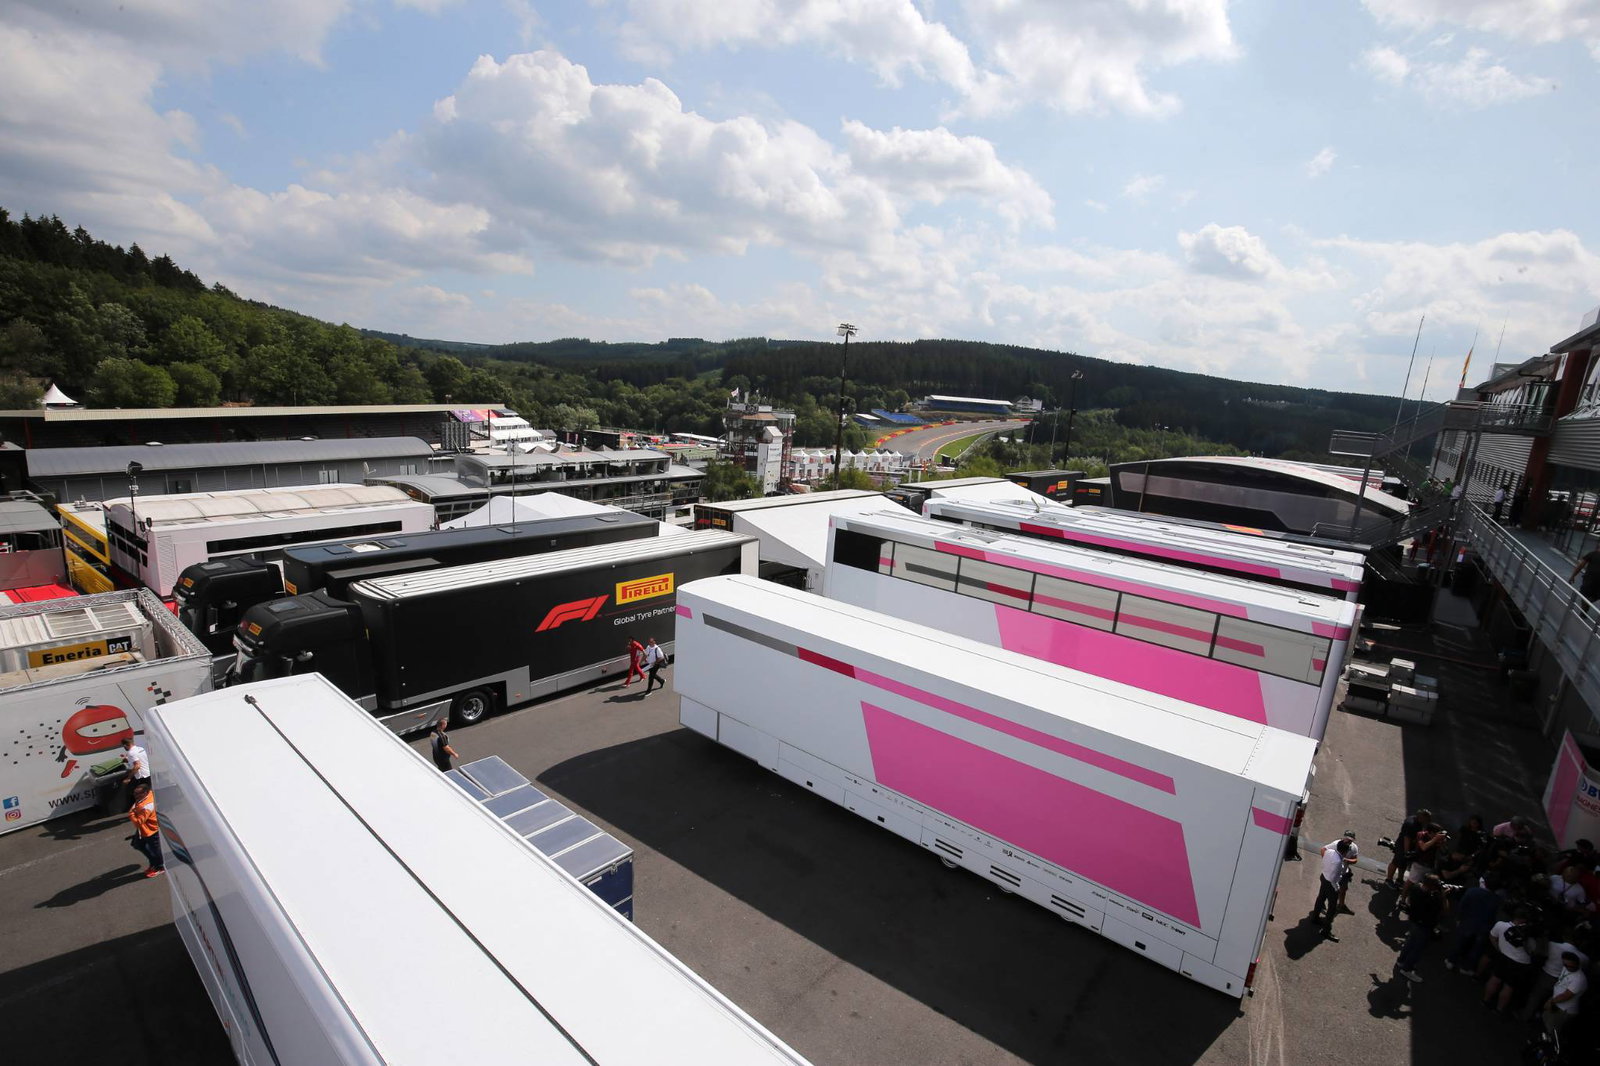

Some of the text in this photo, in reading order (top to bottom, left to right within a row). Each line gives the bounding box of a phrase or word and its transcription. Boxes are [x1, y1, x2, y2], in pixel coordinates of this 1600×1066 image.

[621, 577, 670, 600] PIRELLI
[534, 594, 610, 632] F1
[613, 605, 676, 626] Global Tyre Partner
[42, 641, 129, 665] Eneria CAT
